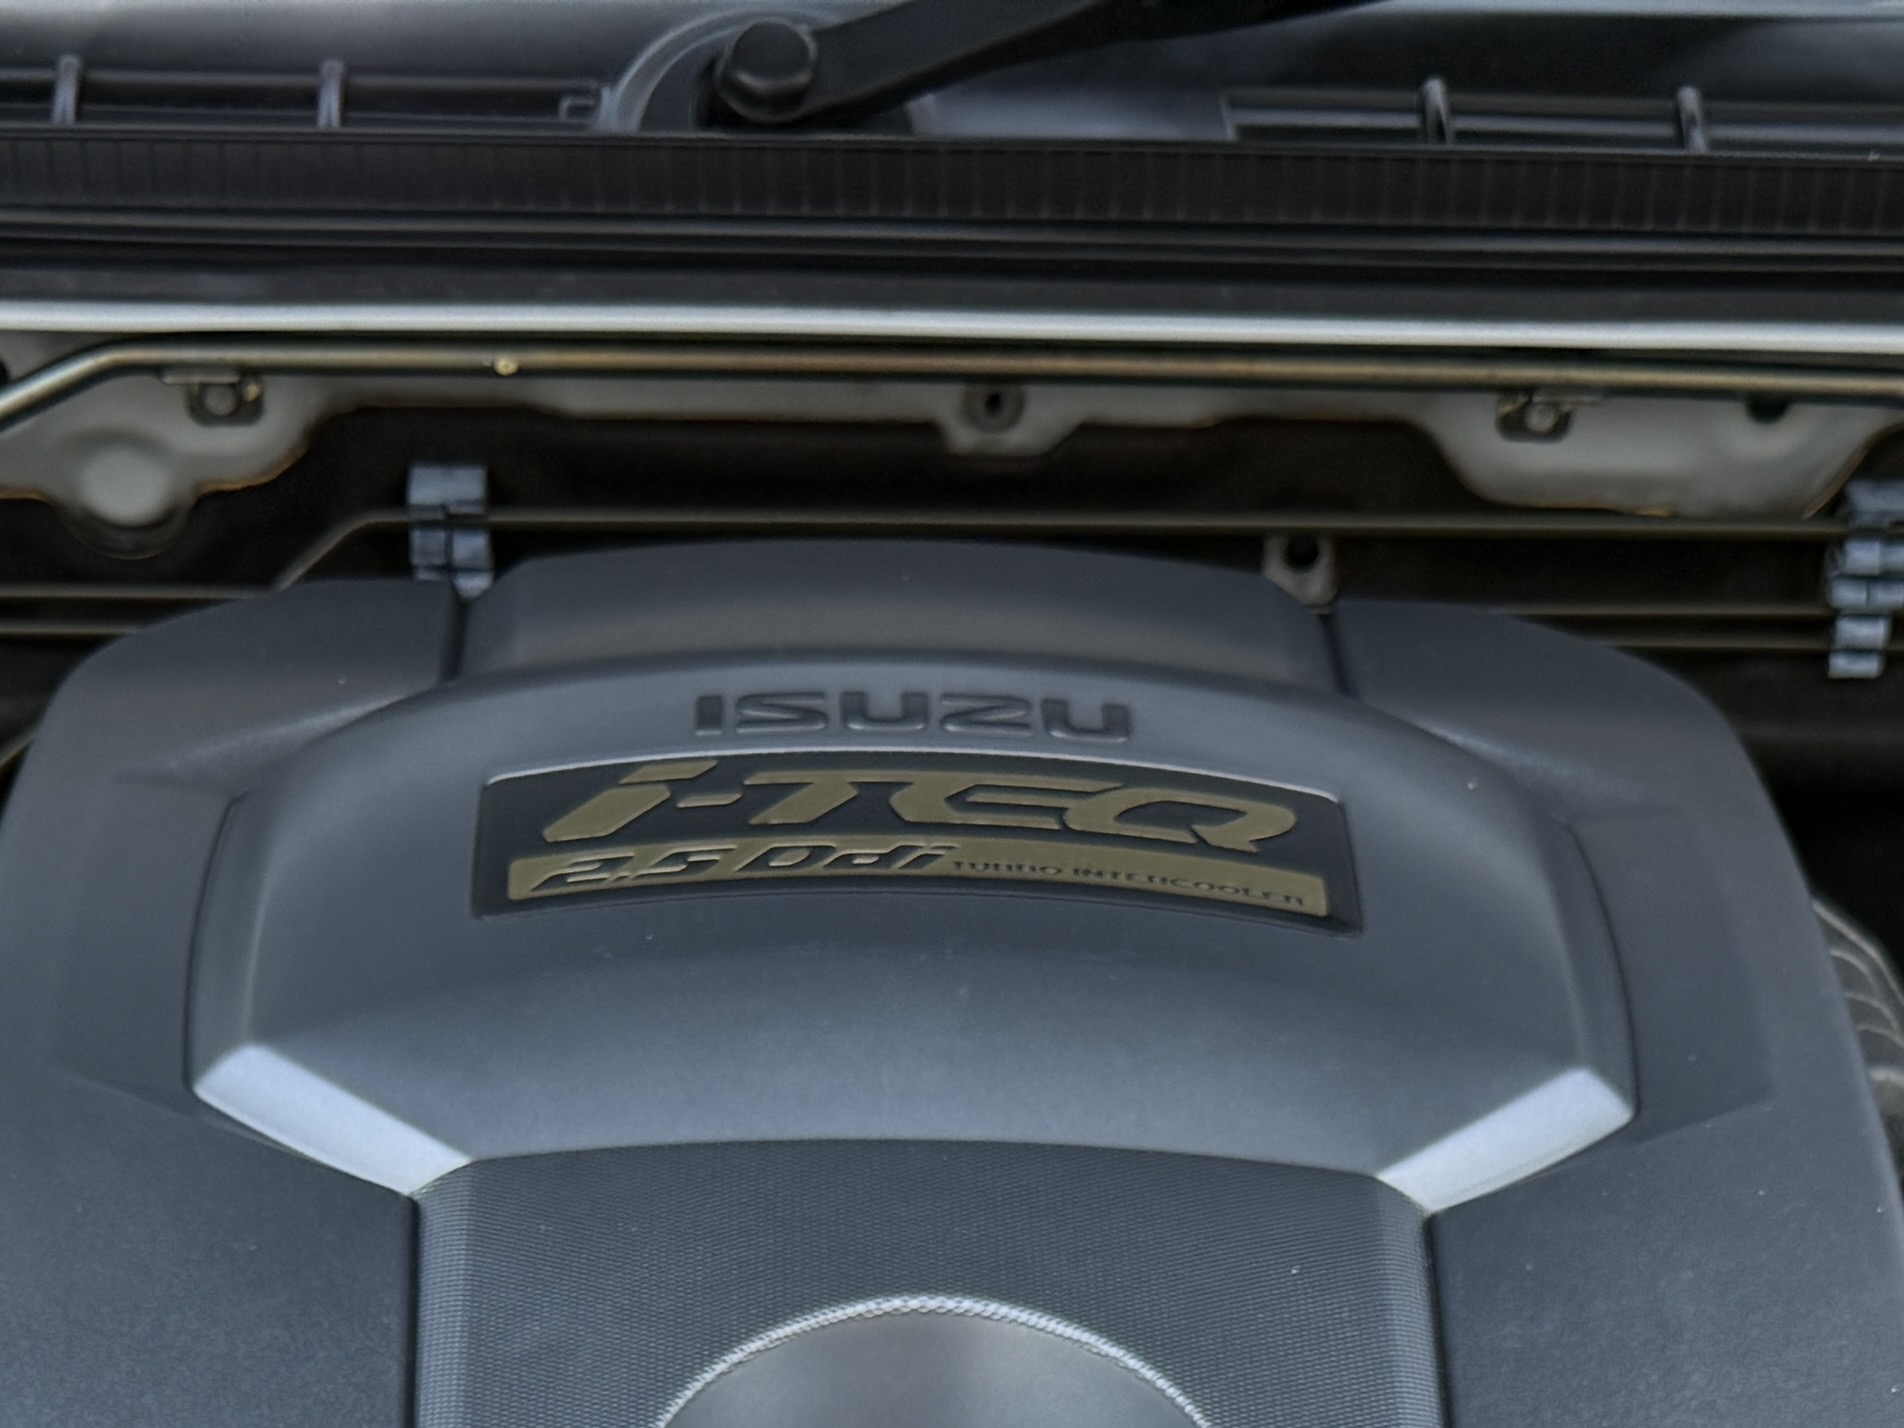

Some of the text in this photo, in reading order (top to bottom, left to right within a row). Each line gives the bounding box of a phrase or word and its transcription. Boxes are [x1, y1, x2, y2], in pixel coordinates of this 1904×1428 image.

[697, 693, 1130, 742] ISUZU
[950, 859, 1063, 878] TURBO
[1071, 866, 1307, 908] INTERCOOLER
